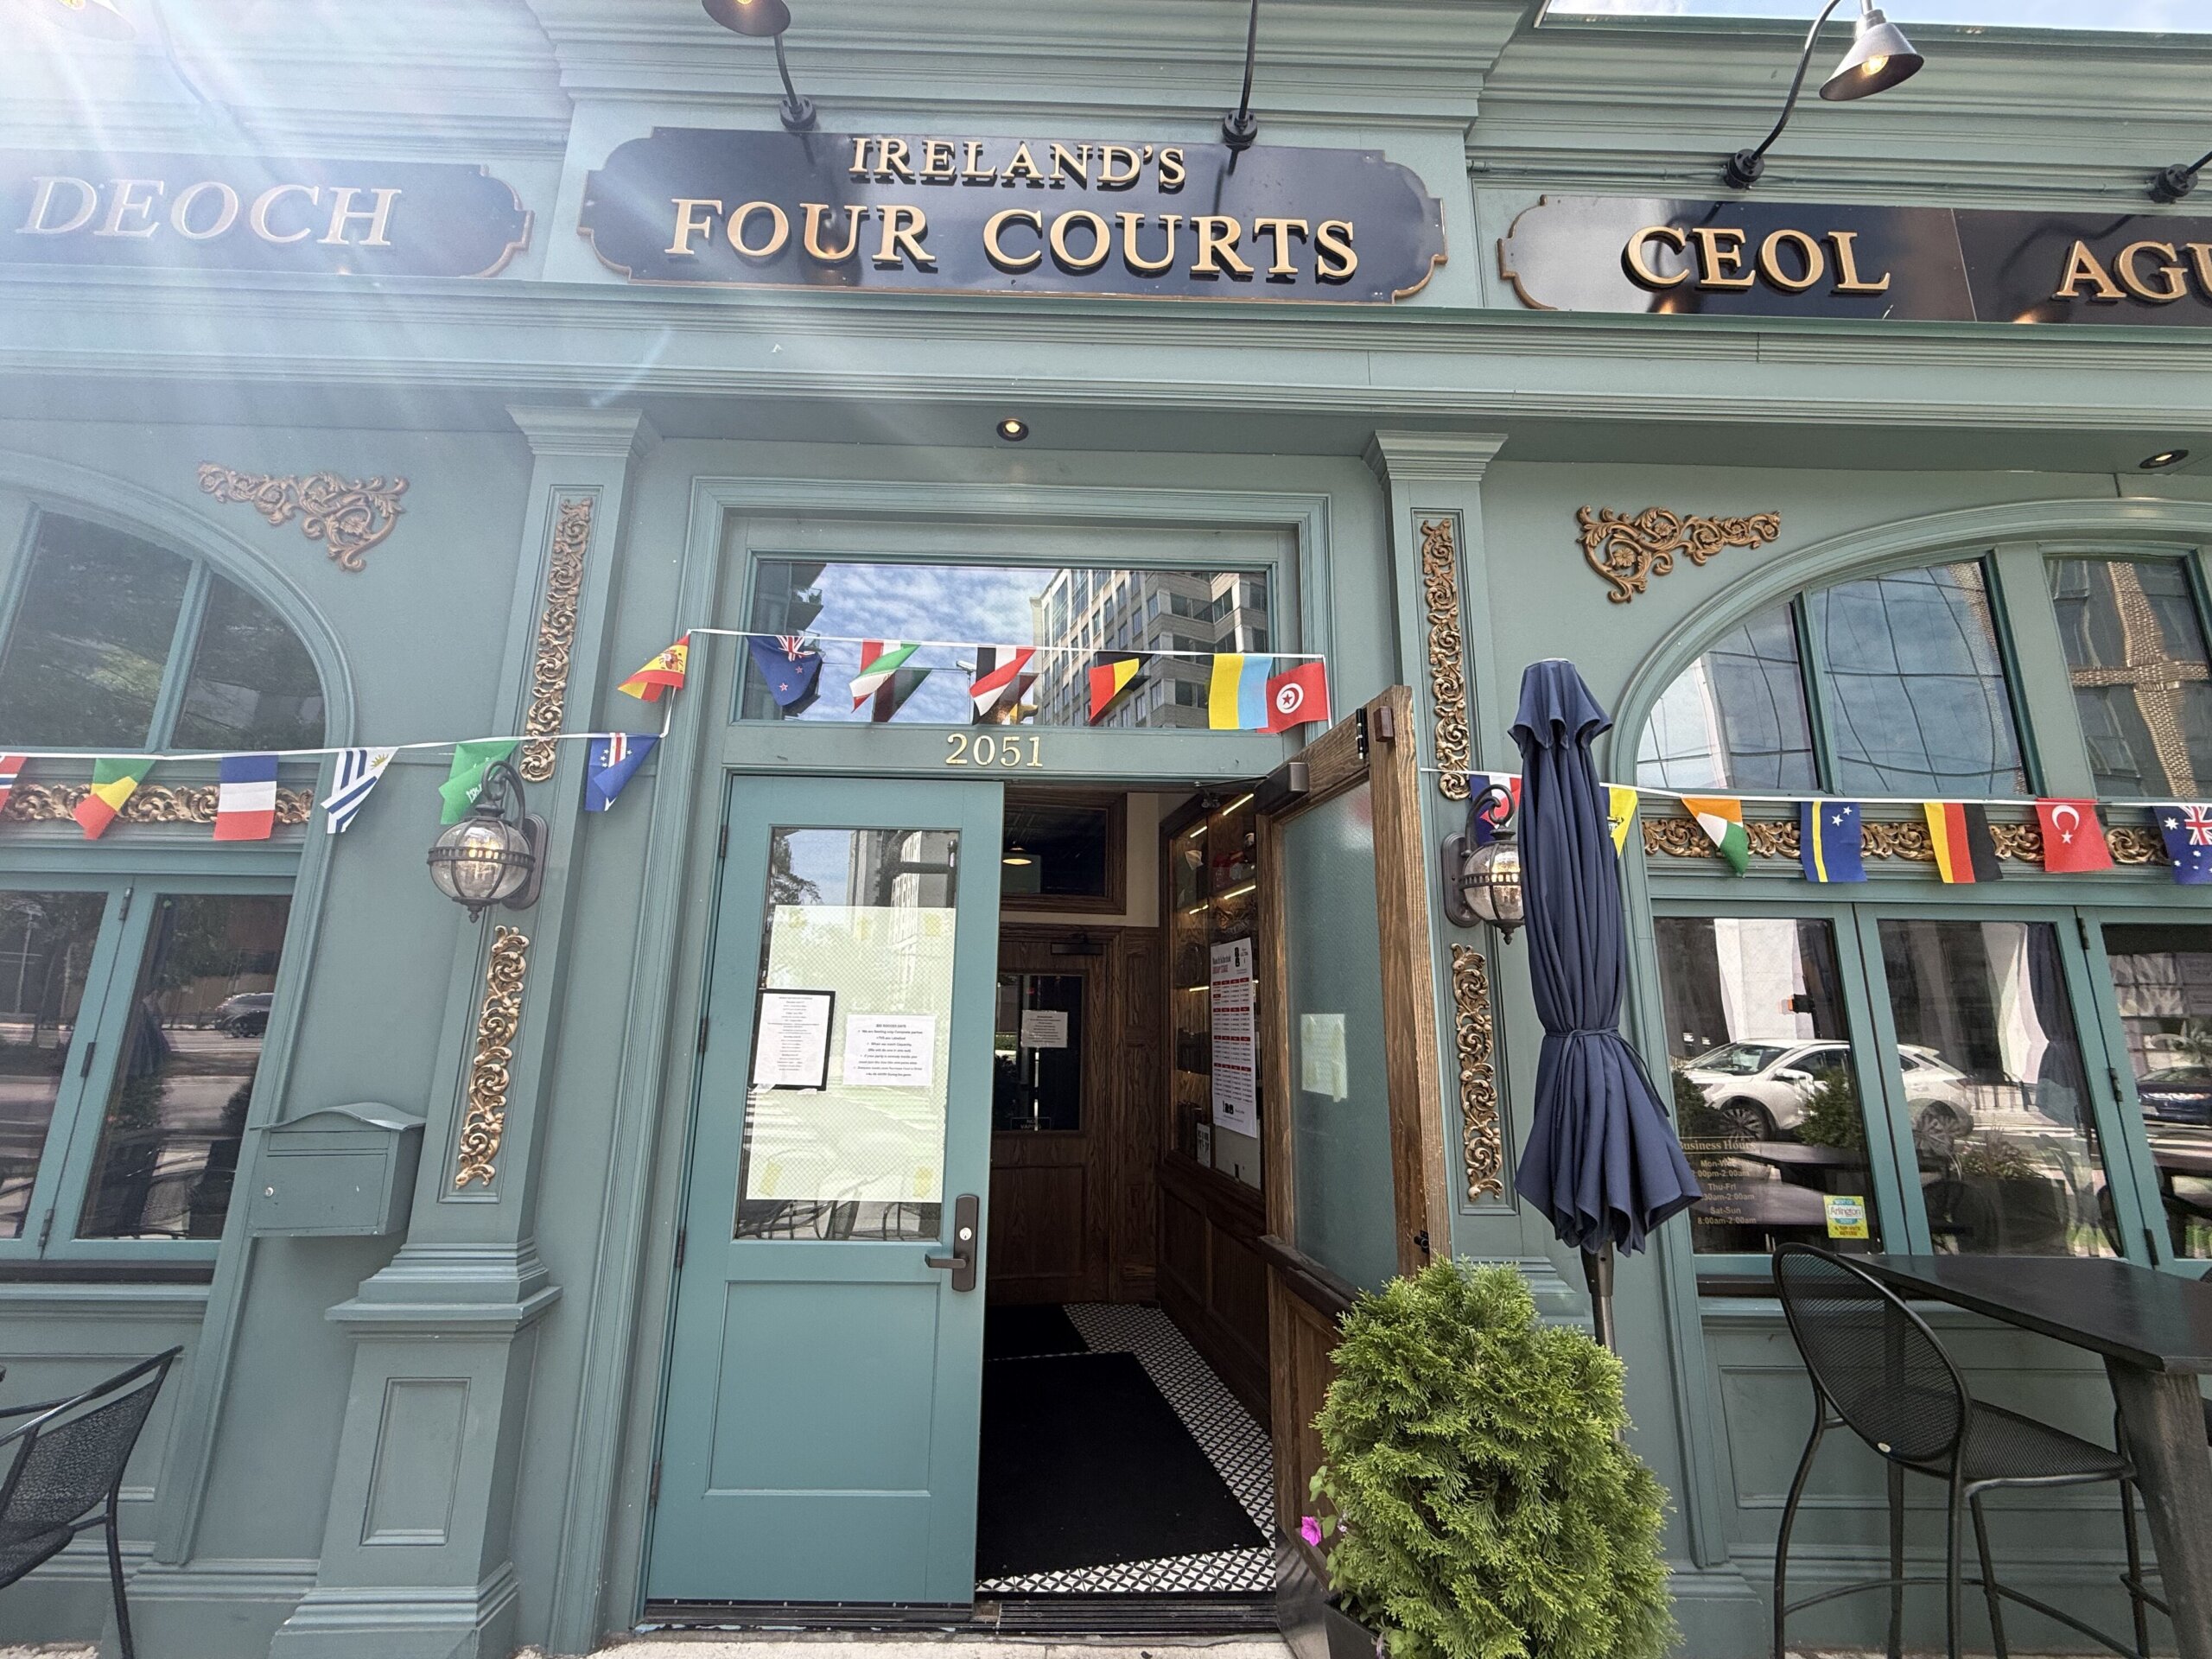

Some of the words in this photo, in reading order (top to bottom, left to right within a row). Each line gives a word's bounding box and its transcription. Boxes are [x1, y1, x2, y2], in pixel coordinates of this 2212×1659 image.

[848, 137, 1185, 187] IRELAND'S
[15, 175, 403, 245] DEOCH
[664, 198, 937, 264] FOUR
[982, 208, 1358, 278] COURTS
[1625, 226, 1891, 291] CEOL
[945, 733, 1043, 767] 2051
[1723, 1139, 1757, 1151] Hours
[1697, 1217, 1757, 1225] 8:00am-2:00am
[1710, 1206, 1742, 1215] Sat-Sun
[1830, 1206, 1861, 1217] Arlington
